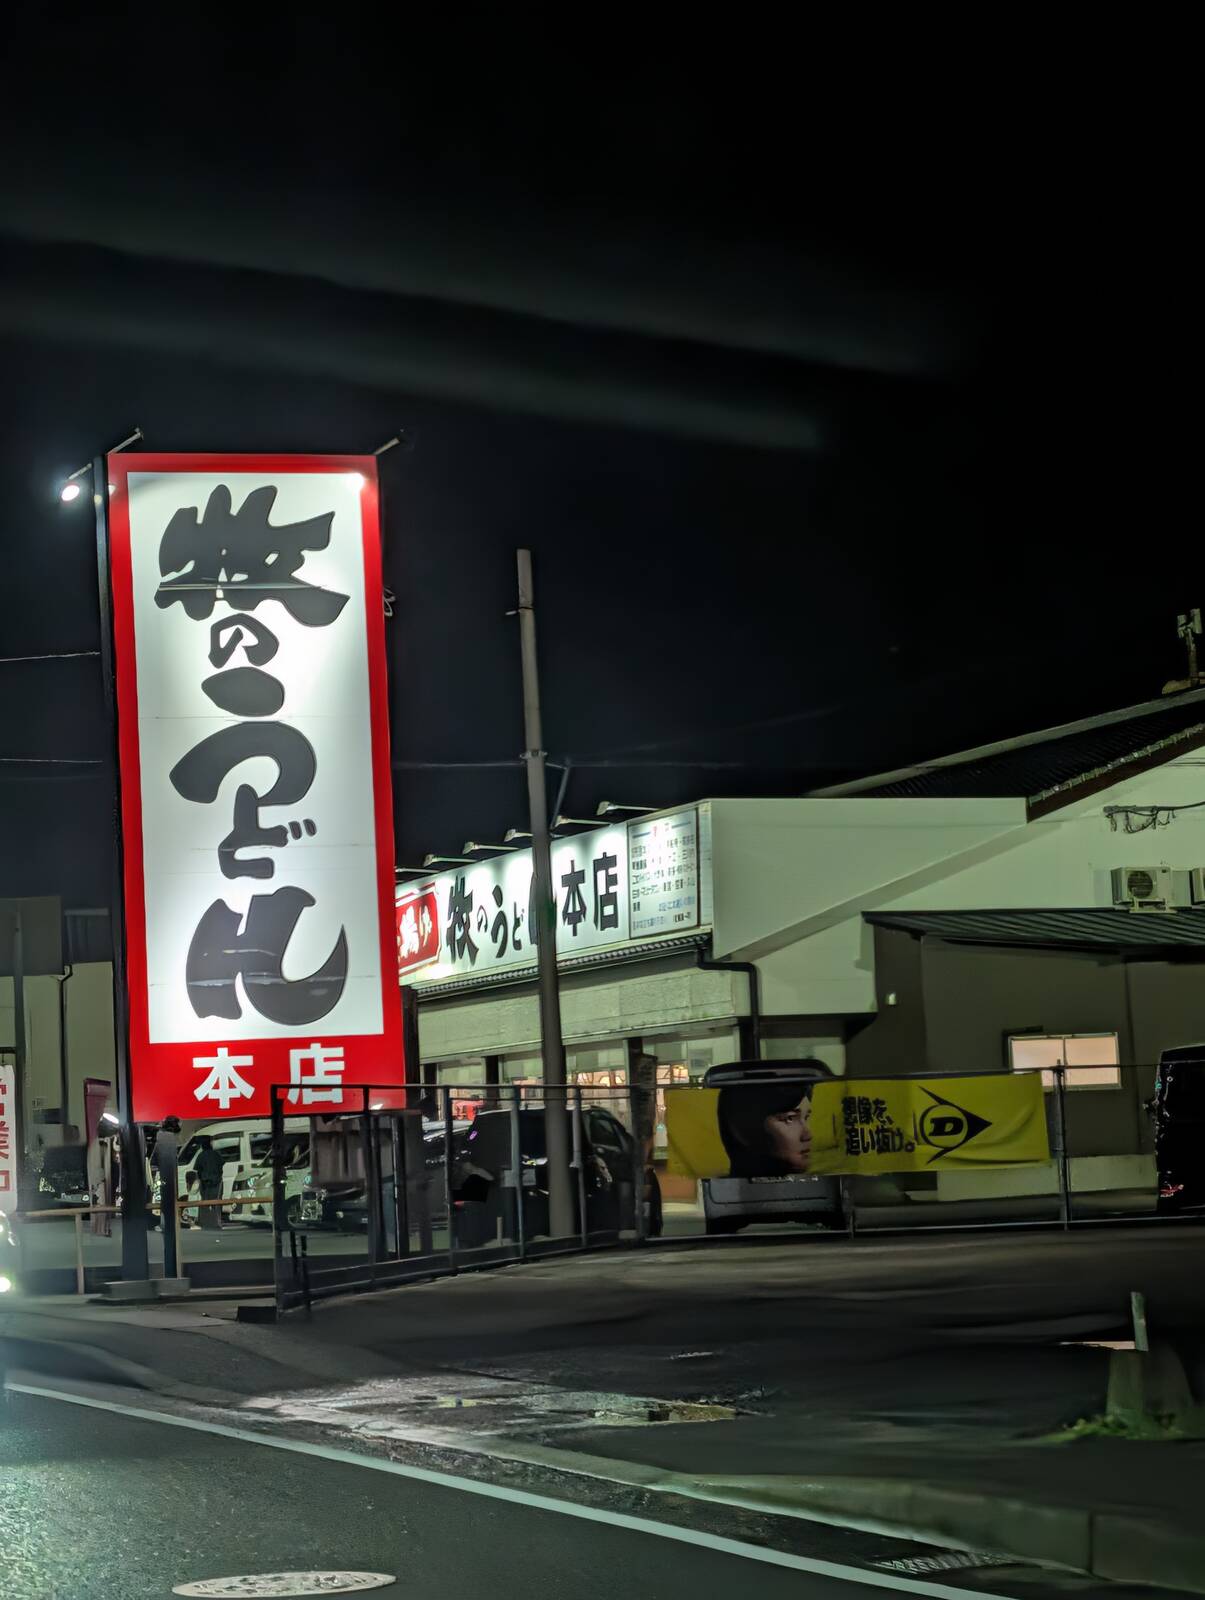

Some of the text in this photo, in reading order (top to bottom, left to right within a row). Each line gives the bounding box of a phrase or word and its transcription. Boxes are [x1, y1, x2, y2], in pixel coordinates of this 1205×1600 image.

[153, 484, 351, 1027] 牧のうどん
[192, 1043, 345, 1109] 本店
[929, 1117, 963, 1136] D
